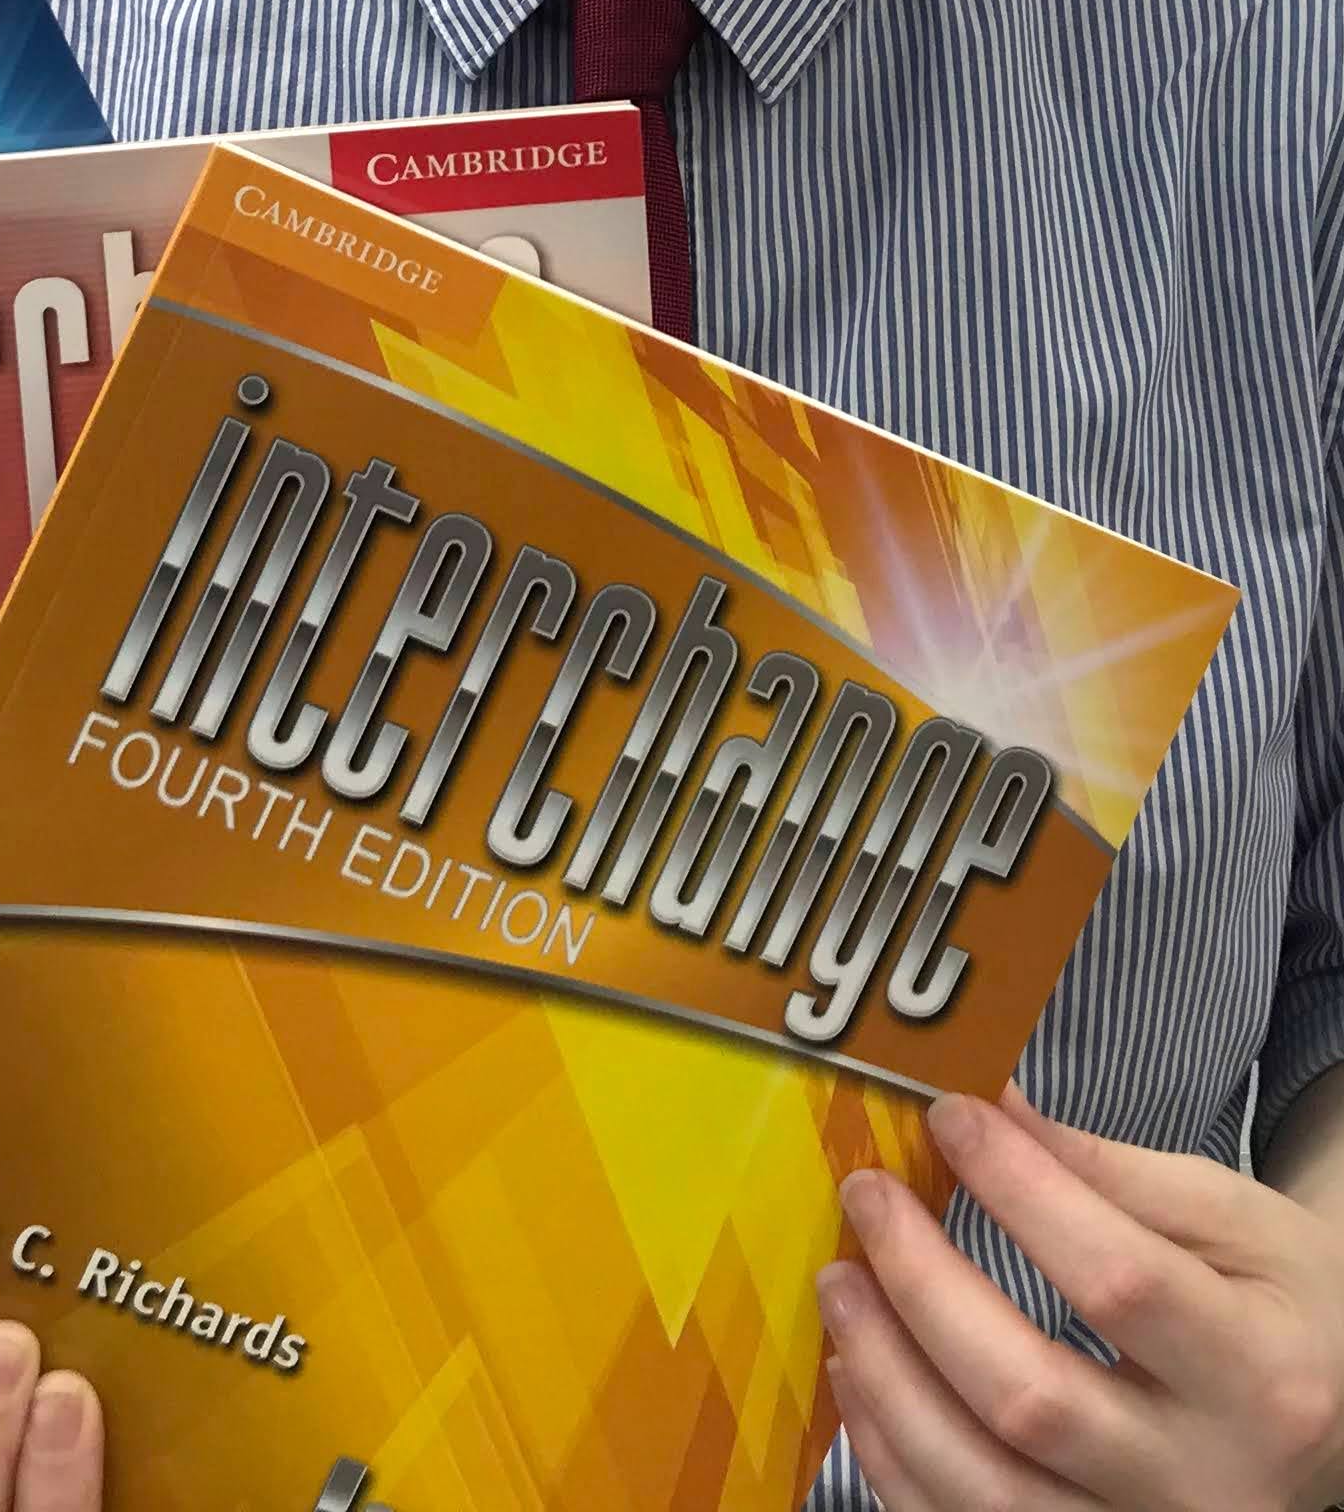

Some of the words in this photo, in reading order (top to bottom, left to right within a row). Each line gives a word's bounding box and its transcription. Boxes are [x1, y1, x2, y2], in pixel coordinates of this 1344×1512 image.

[365, 139, 609, 186] CAMBRIDGE
[233, 184, 445, 296] CAMBRIDGE
[98, 373, 1053, 1044] interchange
[68, 711, 335, 863] FOURTH
[343, 827, 597, 966] EDITION
[11, 1223, 56, 1280] C.
[77, 1246, 309, 1372] Richards
